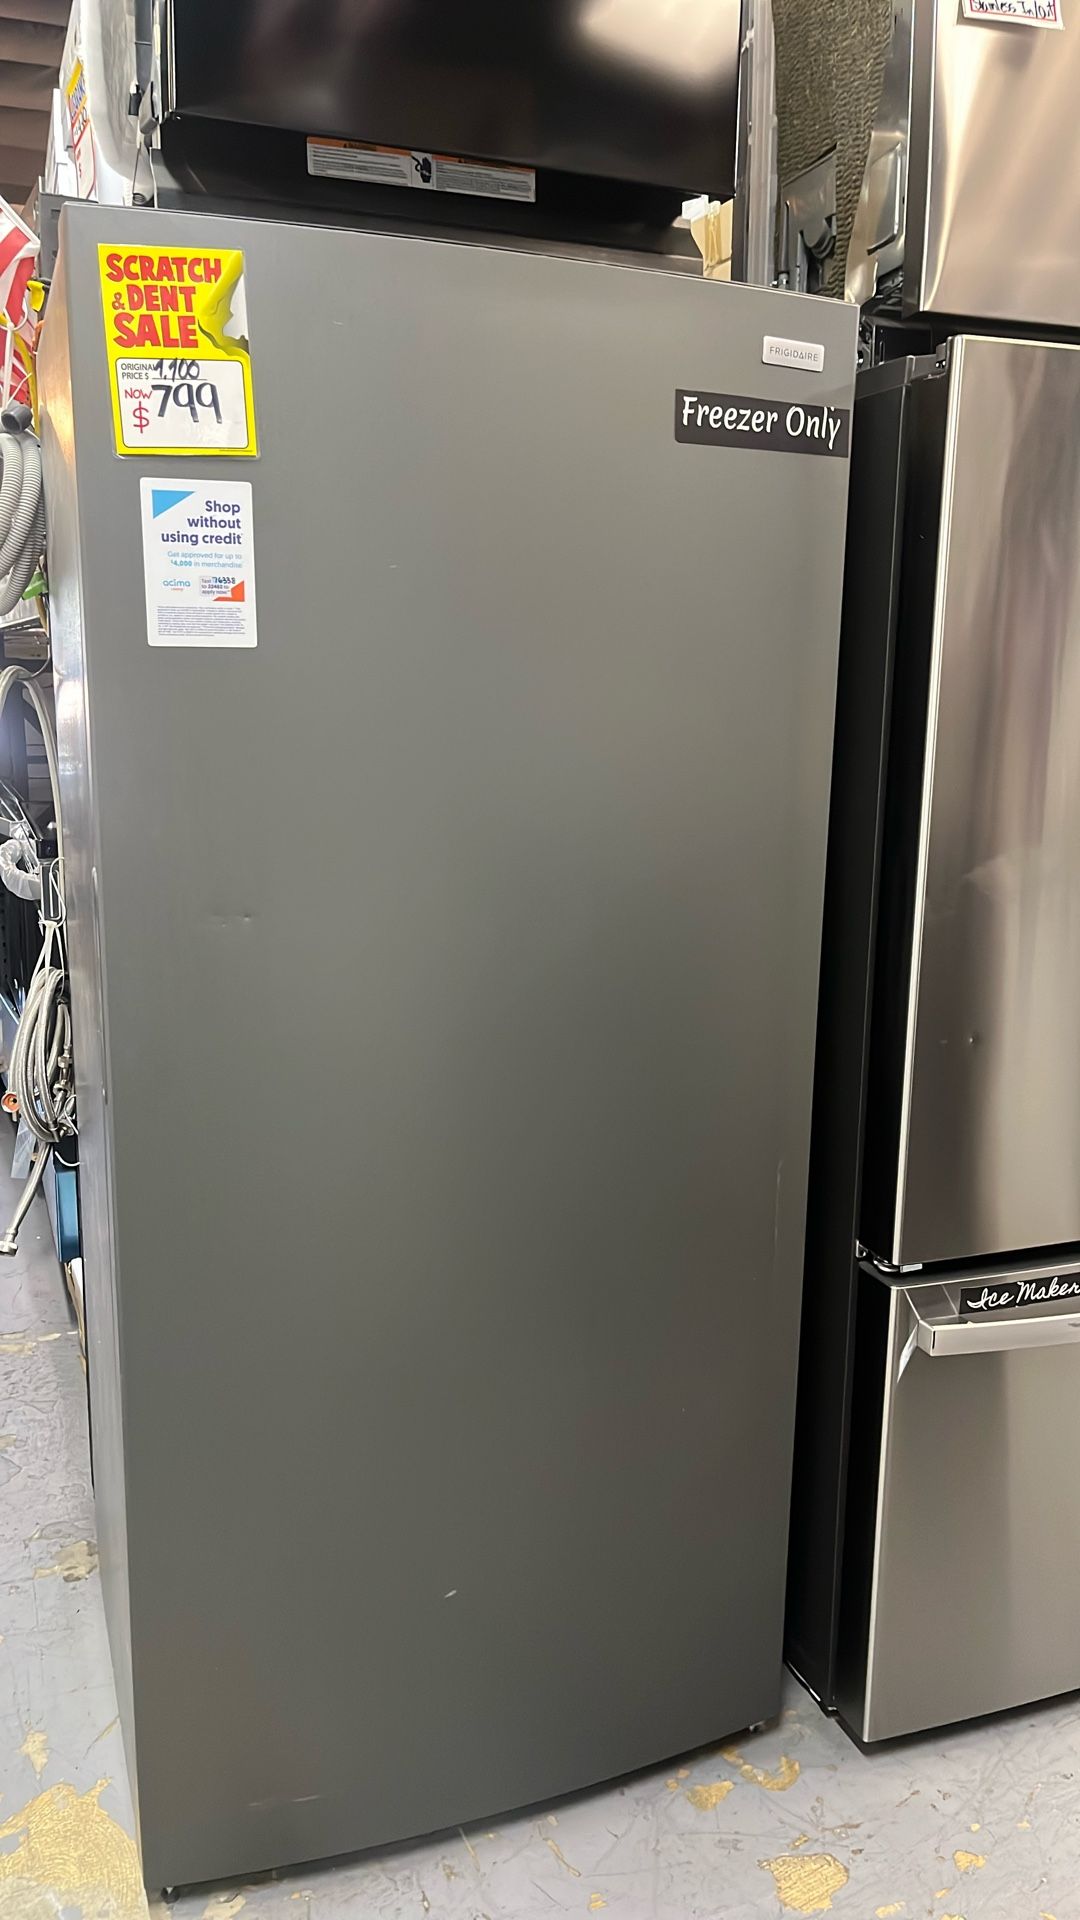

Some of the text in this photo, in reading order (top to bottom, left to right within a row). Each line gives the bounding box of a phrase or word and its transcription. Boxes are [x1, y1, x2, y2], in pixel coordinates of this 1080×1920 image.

[106, 253, 221, 283] SCRATCH
[112, 284, 196, 312] & DENT
[113, 312, 199, 348] SALE
[769, 346, 819, 362] FRIGIDAIRE
[122, 372, 143, 380] PRICE
[124, 388, 152, 399] NOW
[133, 382, 222, 433] $ 799
[682, 396, 841, 450] Freezer Only
[205, 500, 241, 515] Shop
[187, 516, 241, 529] without
[161, 531, 198, 545] using
[162, 578, 191, 587] acima
[967, 1277, 1080, 1310] Ice Maker
